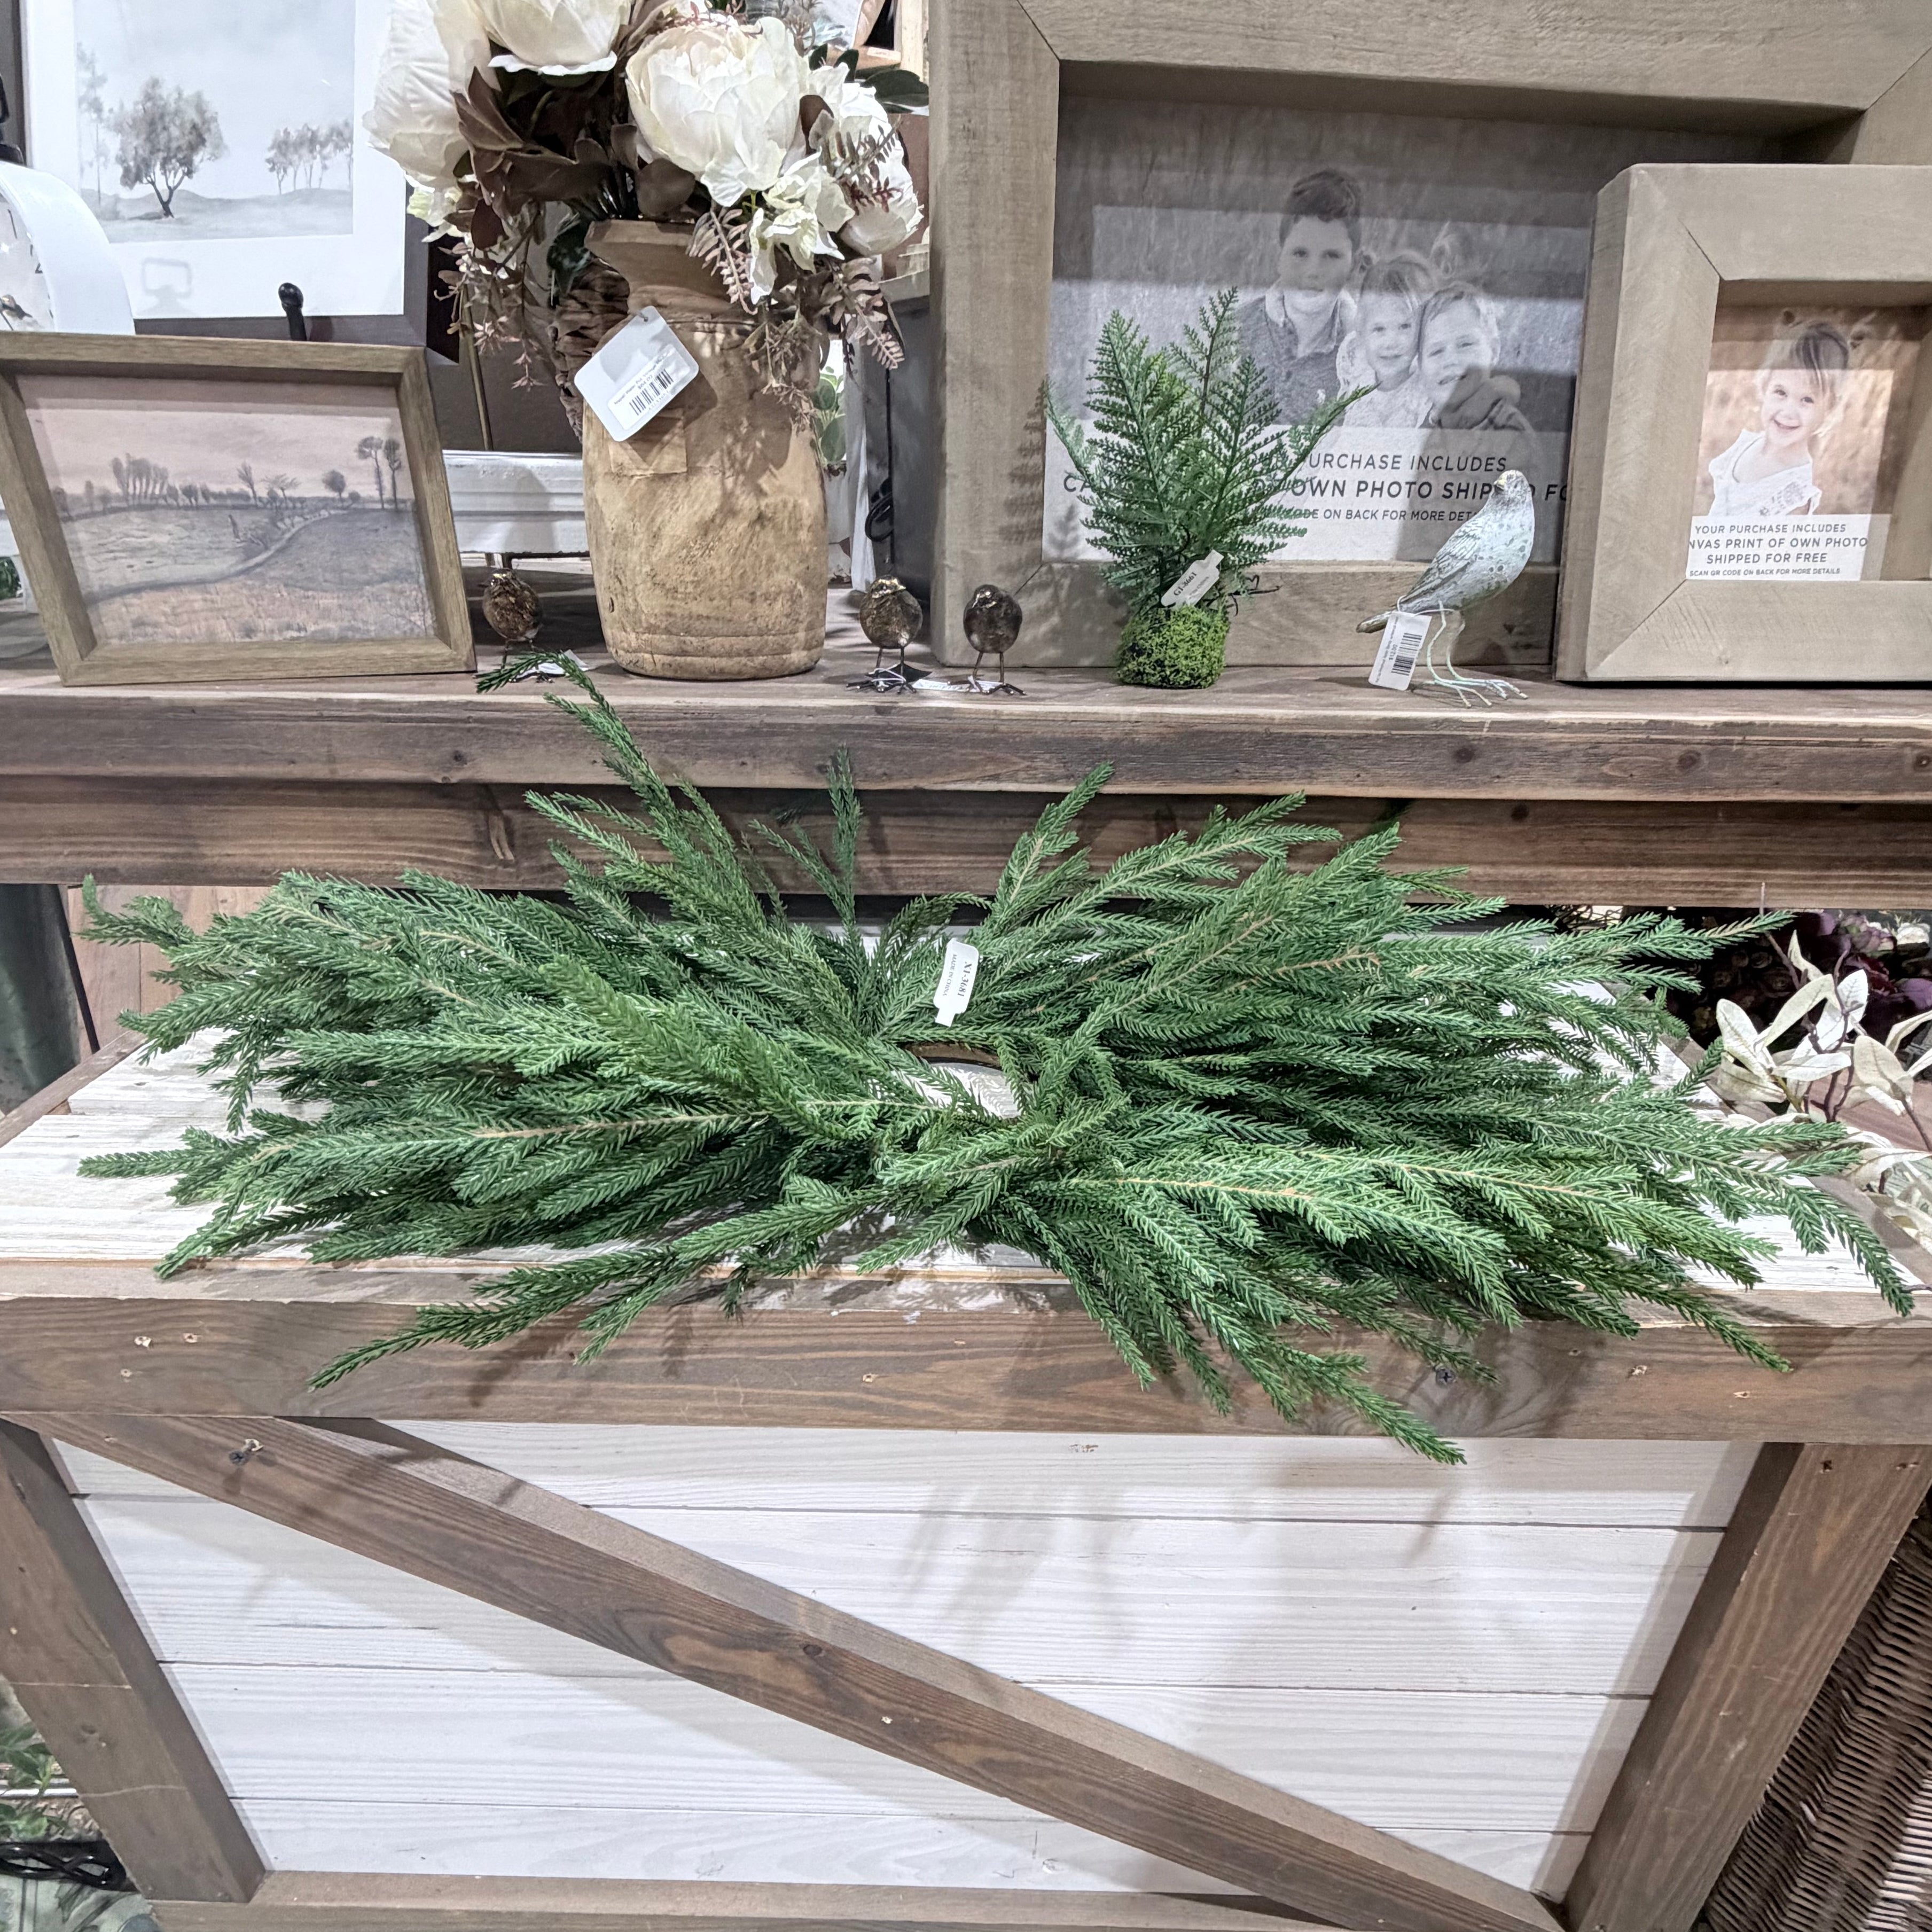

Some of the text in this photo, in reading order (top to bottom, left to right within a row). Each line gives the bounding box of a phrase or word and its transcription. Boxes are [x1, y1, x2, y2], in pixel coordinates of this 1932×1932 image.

[1309, 452, 1506, 472] URCHASE INCLUDES
[1291, 479, 1346, 497] OWN
[1356, 480, 1432, 499] PHOTO
[1442, 481, 1536, 500] SHIP
[1324, 509, 1341, 519] ON
[1345, 509, 1379, 520] BACK
[1382, 510, 1406, 521] FOR
[1411, 510, 1445, 522] MORE
[1695, 523, 1846, 534] YOUR PURCHASE INCLUDES
[1726, 538, 1763, 549] PRINT
[1769, 538, 1785, 548] OF
[1790, 537, 1820, 547] OWN
[1825, 537, 1868, 547] PHOTO
[1707, 552, 1827, 564] SHIPPED FOR FREE
